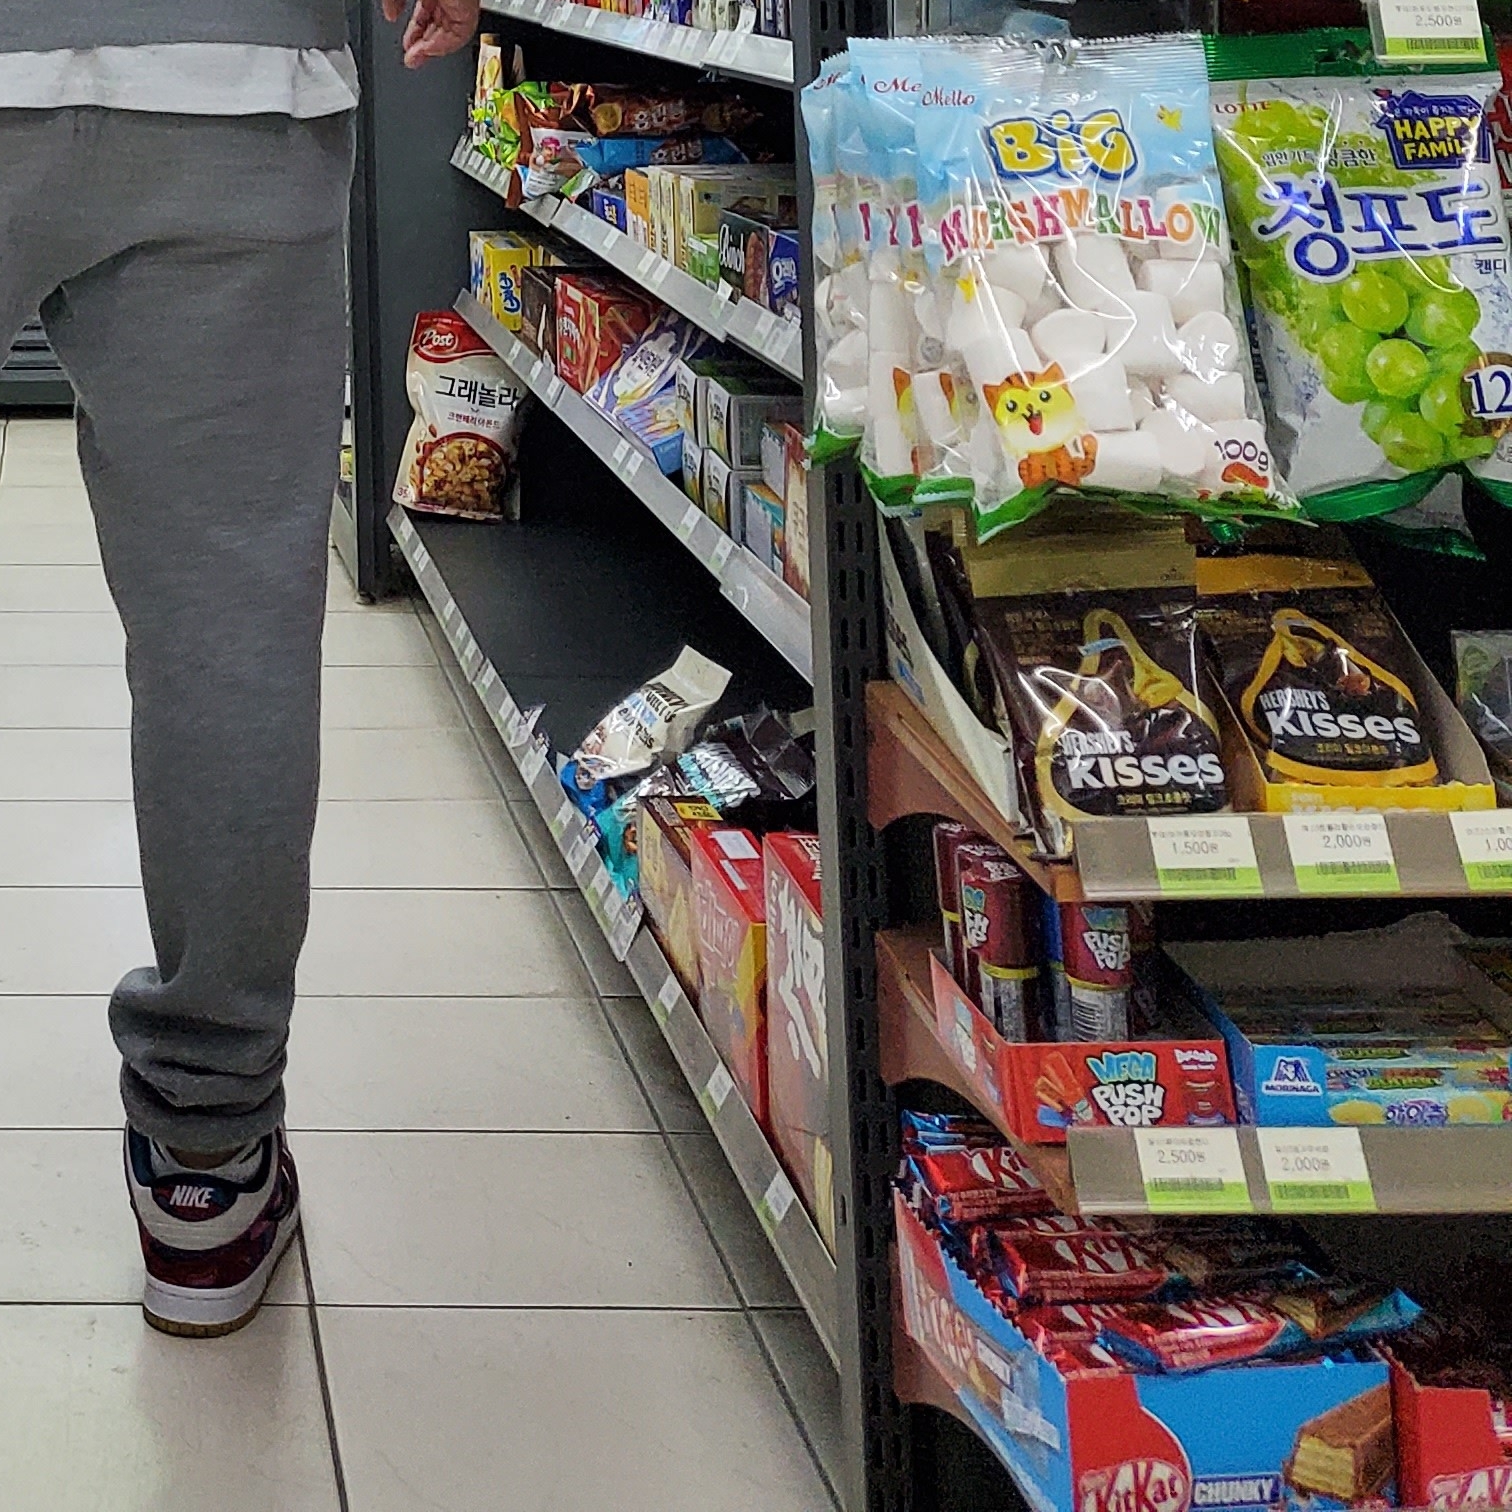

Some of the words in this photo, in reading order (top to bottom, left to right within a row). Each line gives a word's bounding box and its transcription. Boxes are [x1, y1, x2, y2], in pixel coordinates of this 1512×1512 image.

[1215, 99, 1272, 116] LOTTE
[1394, 115, 1480, 141] HAPPY
[940, 188, 1223, 261] MARSHMALLOW
[1258, 178, 1506, 281] 청포도
[1473, 257, 1507, 276] 캔디
[420, 327, 456, 352] Post
[435, 373, 520, 412] 그래놀라
[1213, 438, 1269, 473] 100g
[1259, 689, 1329, 712] HERSHEY'S
[1082, 930, 1130, 951] PUSH
[1095, 948, 1131, 970] POP
[1087, 1050, 1157, 1084] MEGA
[1091, 1082, 1165, 1108] PUSH
[1107, 1104, 1164, 1127] POP
[169, 1185, 213, 1210] NIKE
[1192, 1478, 1275, 1504] CHUNKY
